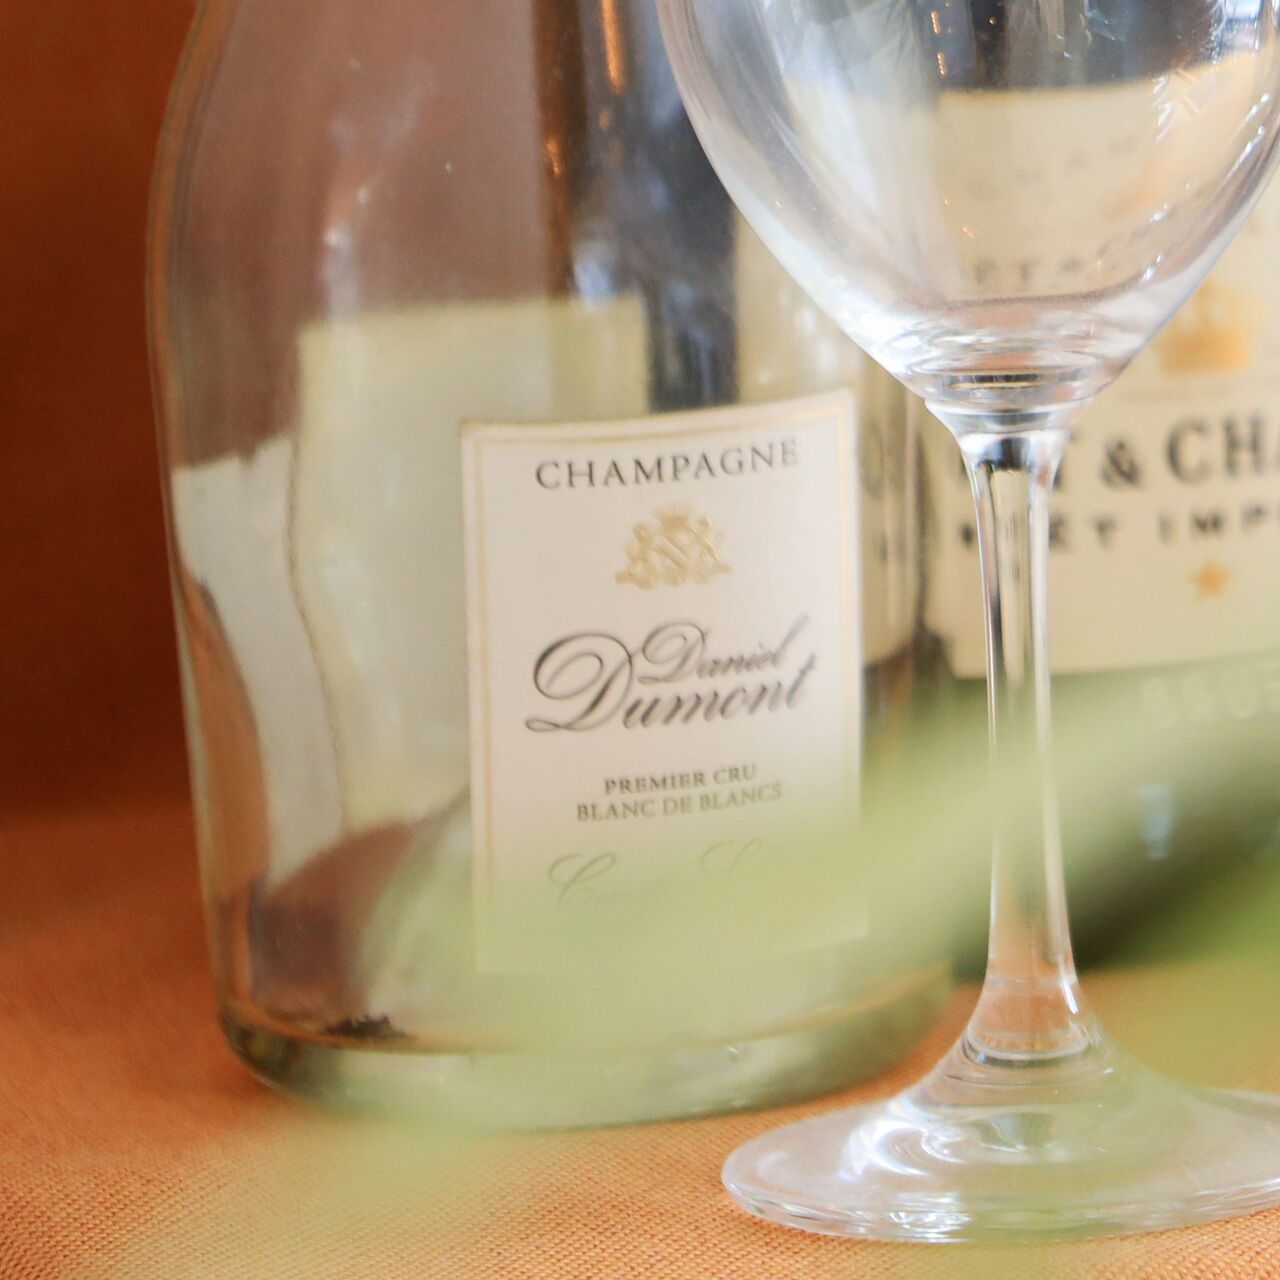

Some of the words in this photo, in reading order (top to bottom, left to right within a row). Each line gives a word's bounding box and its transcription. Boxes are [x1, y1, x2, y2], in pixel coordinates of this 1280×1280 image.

[535, 437, 799, 490] CHAMPAGNE
[1097, 428, 1147, 493] &
[637, 614, 810, 685] Daniel
[525, 629, 818, 733] Dumont
[576, 799, 656, 822] BLANC
[661, 794, 693, 816] DE
[699, 781, 783, 813] BLANCS
[604, 770, 706, 796] PREMIER
[713, 764, 758, 787] CRU
